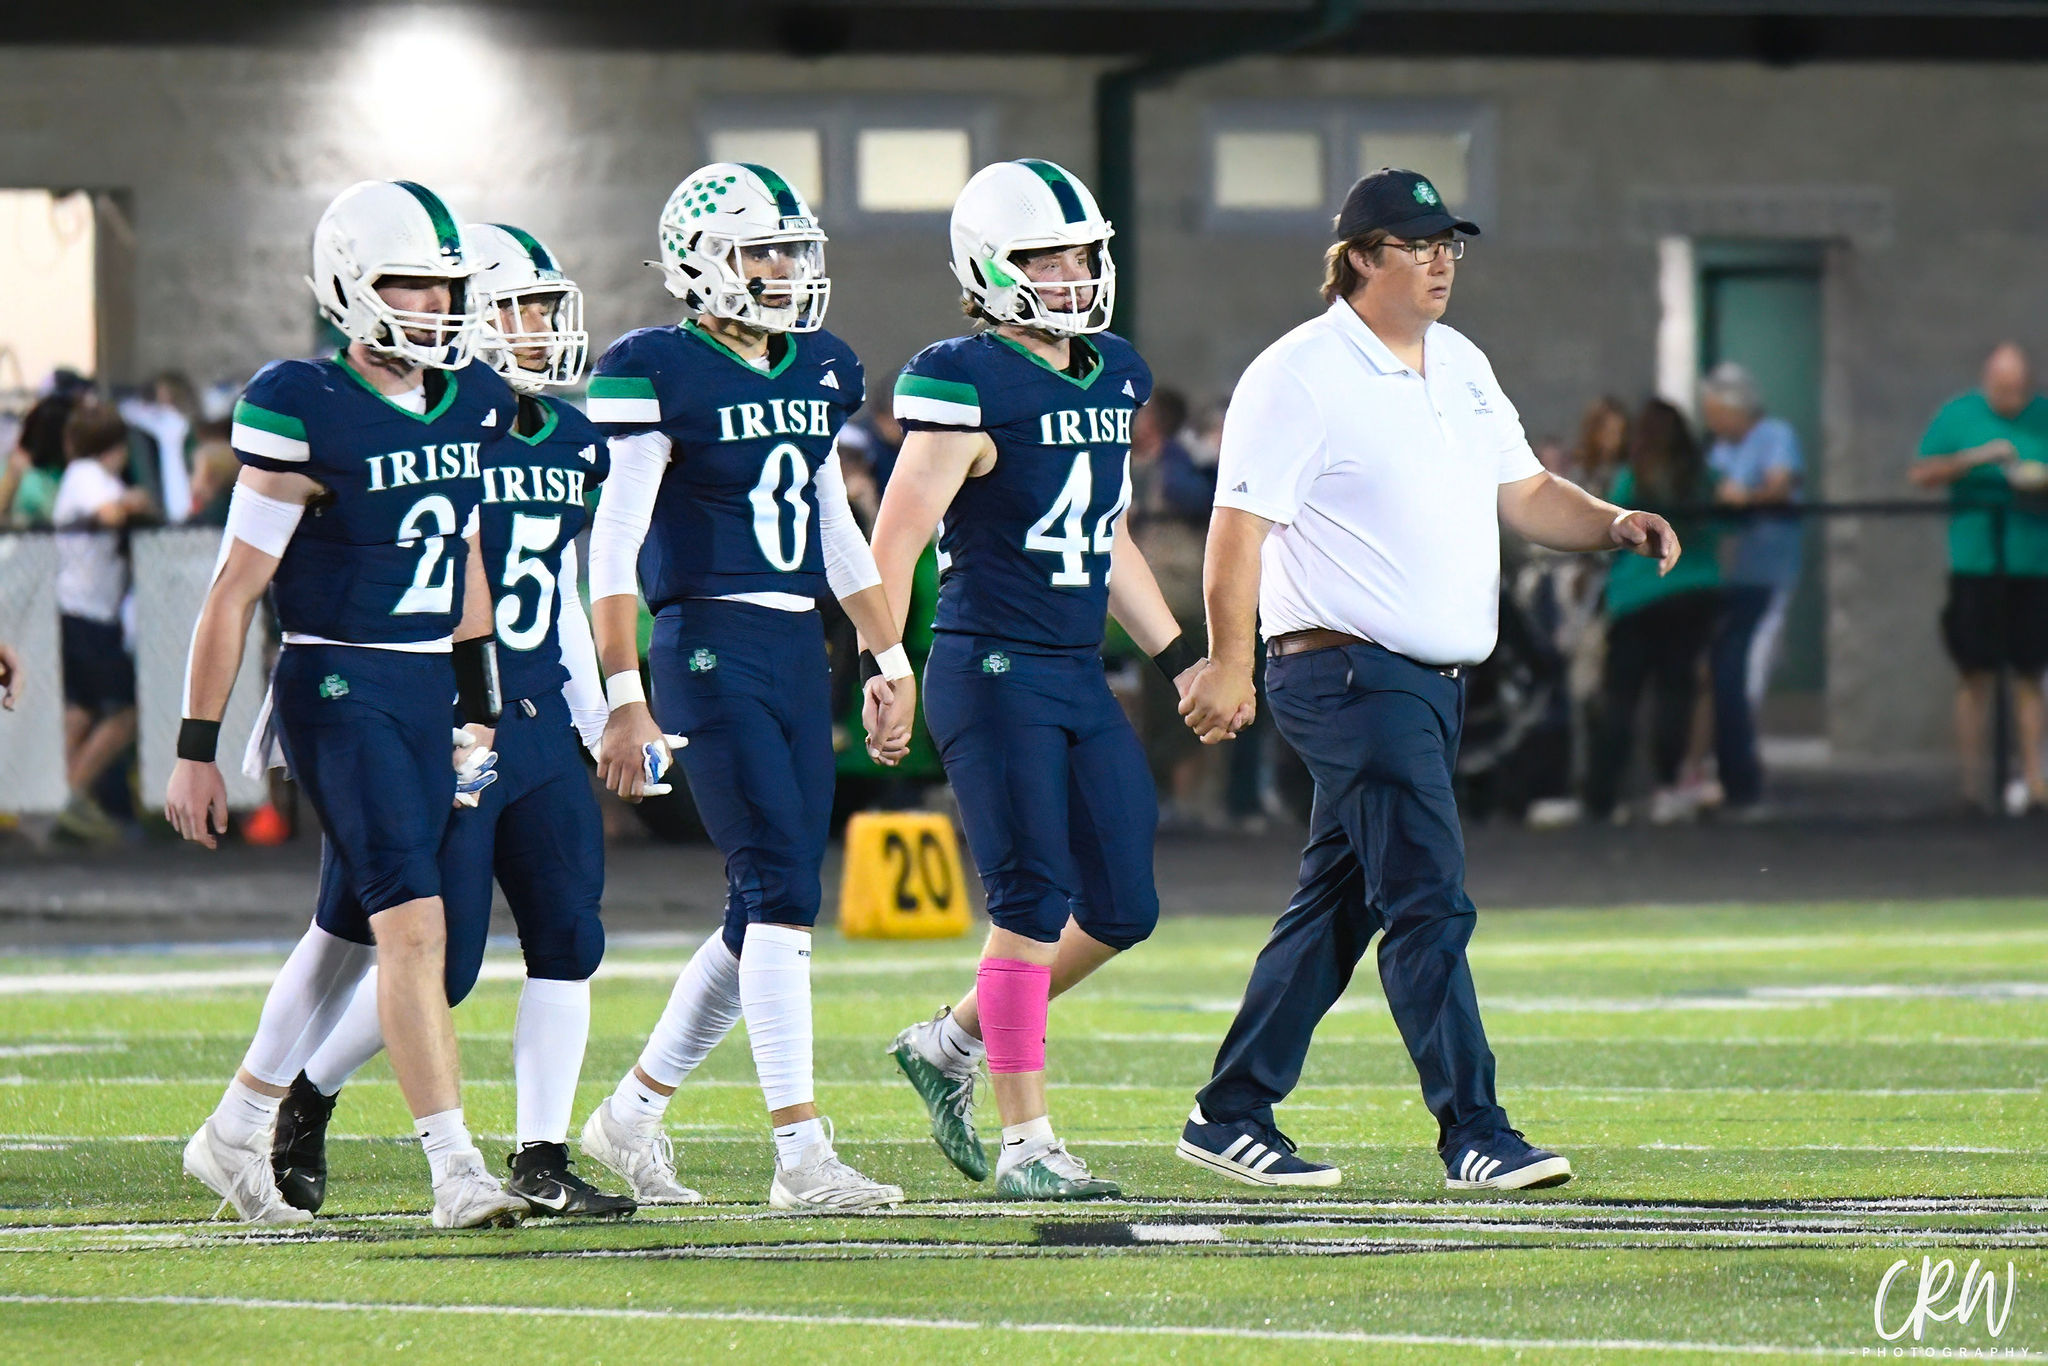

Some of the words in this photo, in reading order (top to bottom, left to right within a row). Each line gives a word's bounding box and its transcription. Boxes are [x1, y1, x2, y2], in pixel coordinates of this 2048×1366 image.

[718, 399, 830, 441] IRISH
[1039, 408, 1133, 445] IRISH
[366, 442, 480, 491] IRISH
[482, 466, 584, 506] IRISH
[749, 443, 811, 572] 0
[391, 494, 455, 615] 2
[495, 513, 561, 650] 5
[882, 829, 952, 912] 20
